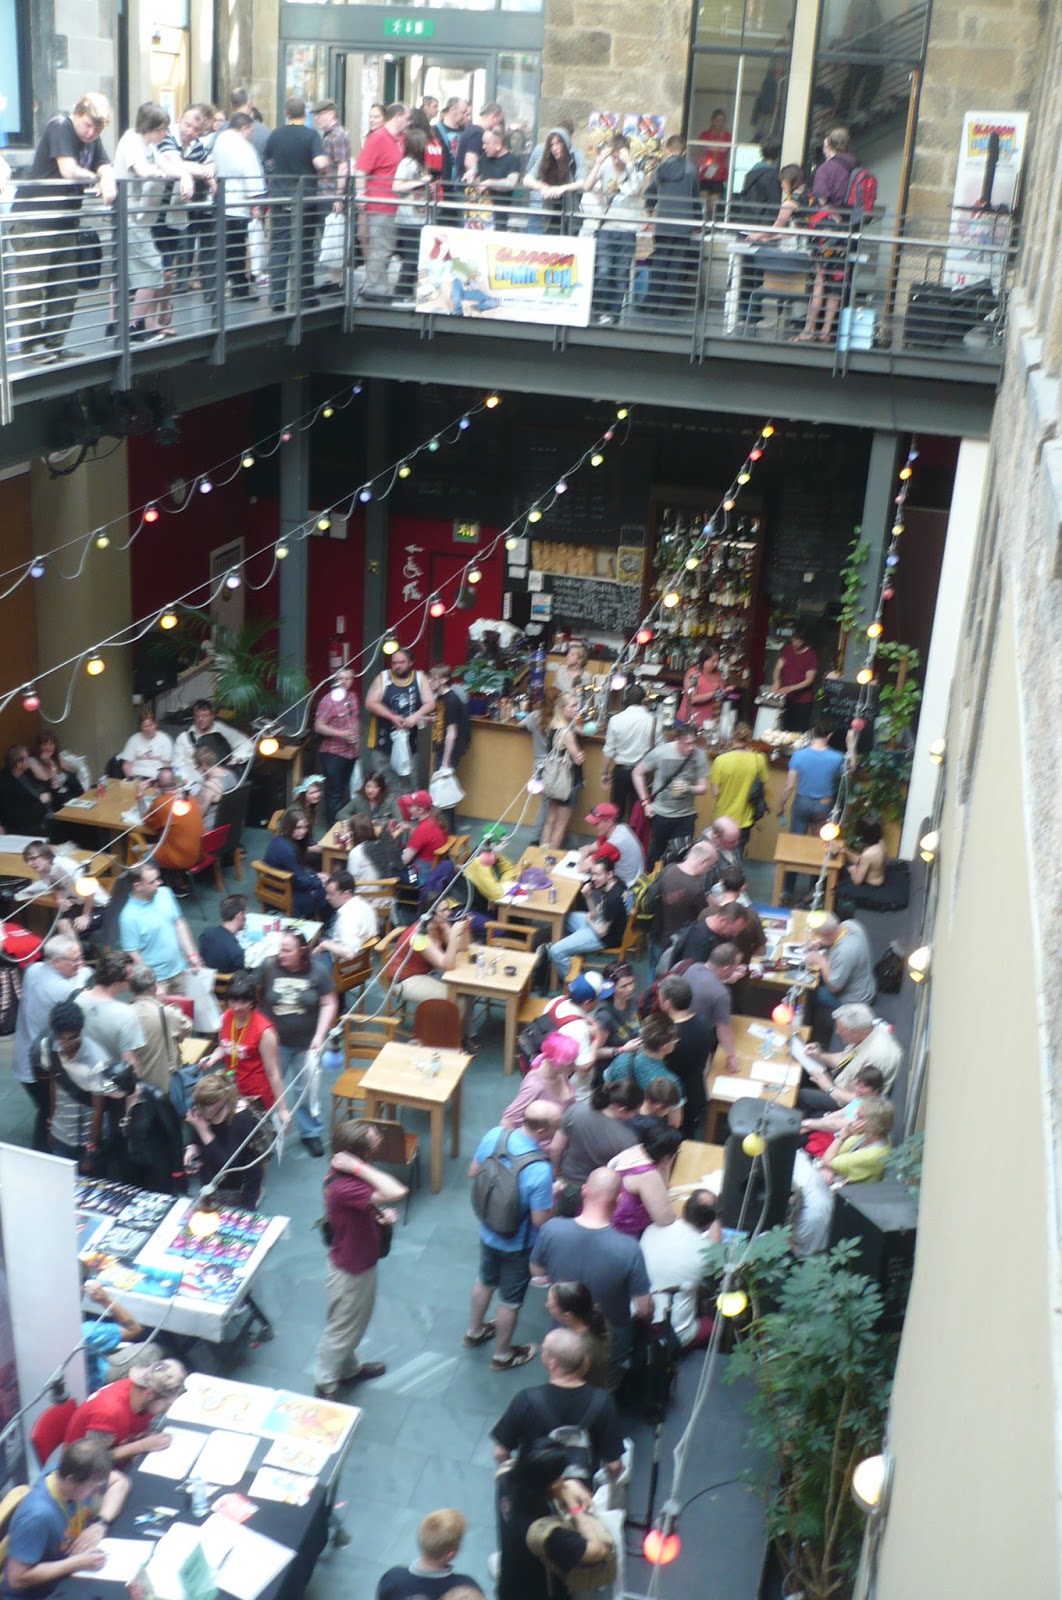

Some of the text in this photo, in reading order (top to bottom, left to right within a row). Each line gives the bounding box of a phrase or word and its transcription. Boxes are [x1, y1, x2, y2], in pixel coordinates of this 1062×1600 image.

[496, 247, 575, 267] GLASGOW
[495, 266, 572, 289] COMIC CON
